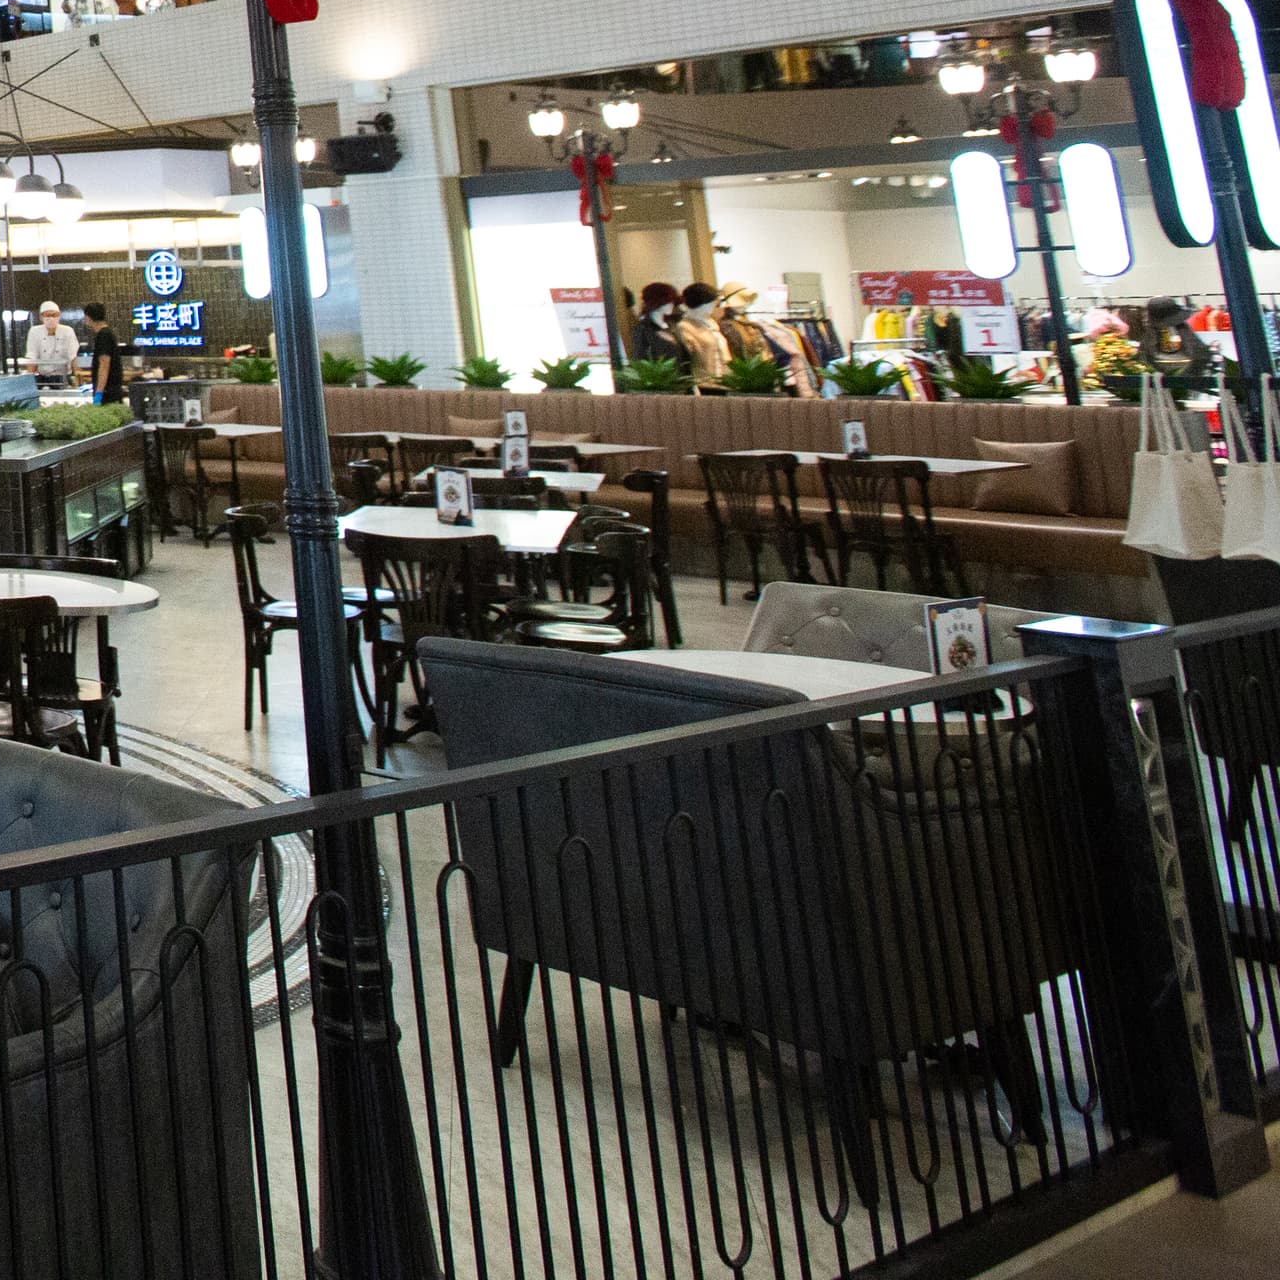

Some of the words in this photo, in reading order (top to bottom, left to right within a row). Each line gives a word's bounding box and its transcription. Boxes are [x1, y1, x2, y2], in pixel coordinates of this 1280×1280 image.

[132, 301, 203, 330] 丰盛町
[180, 336, 203, 346] PLACE
